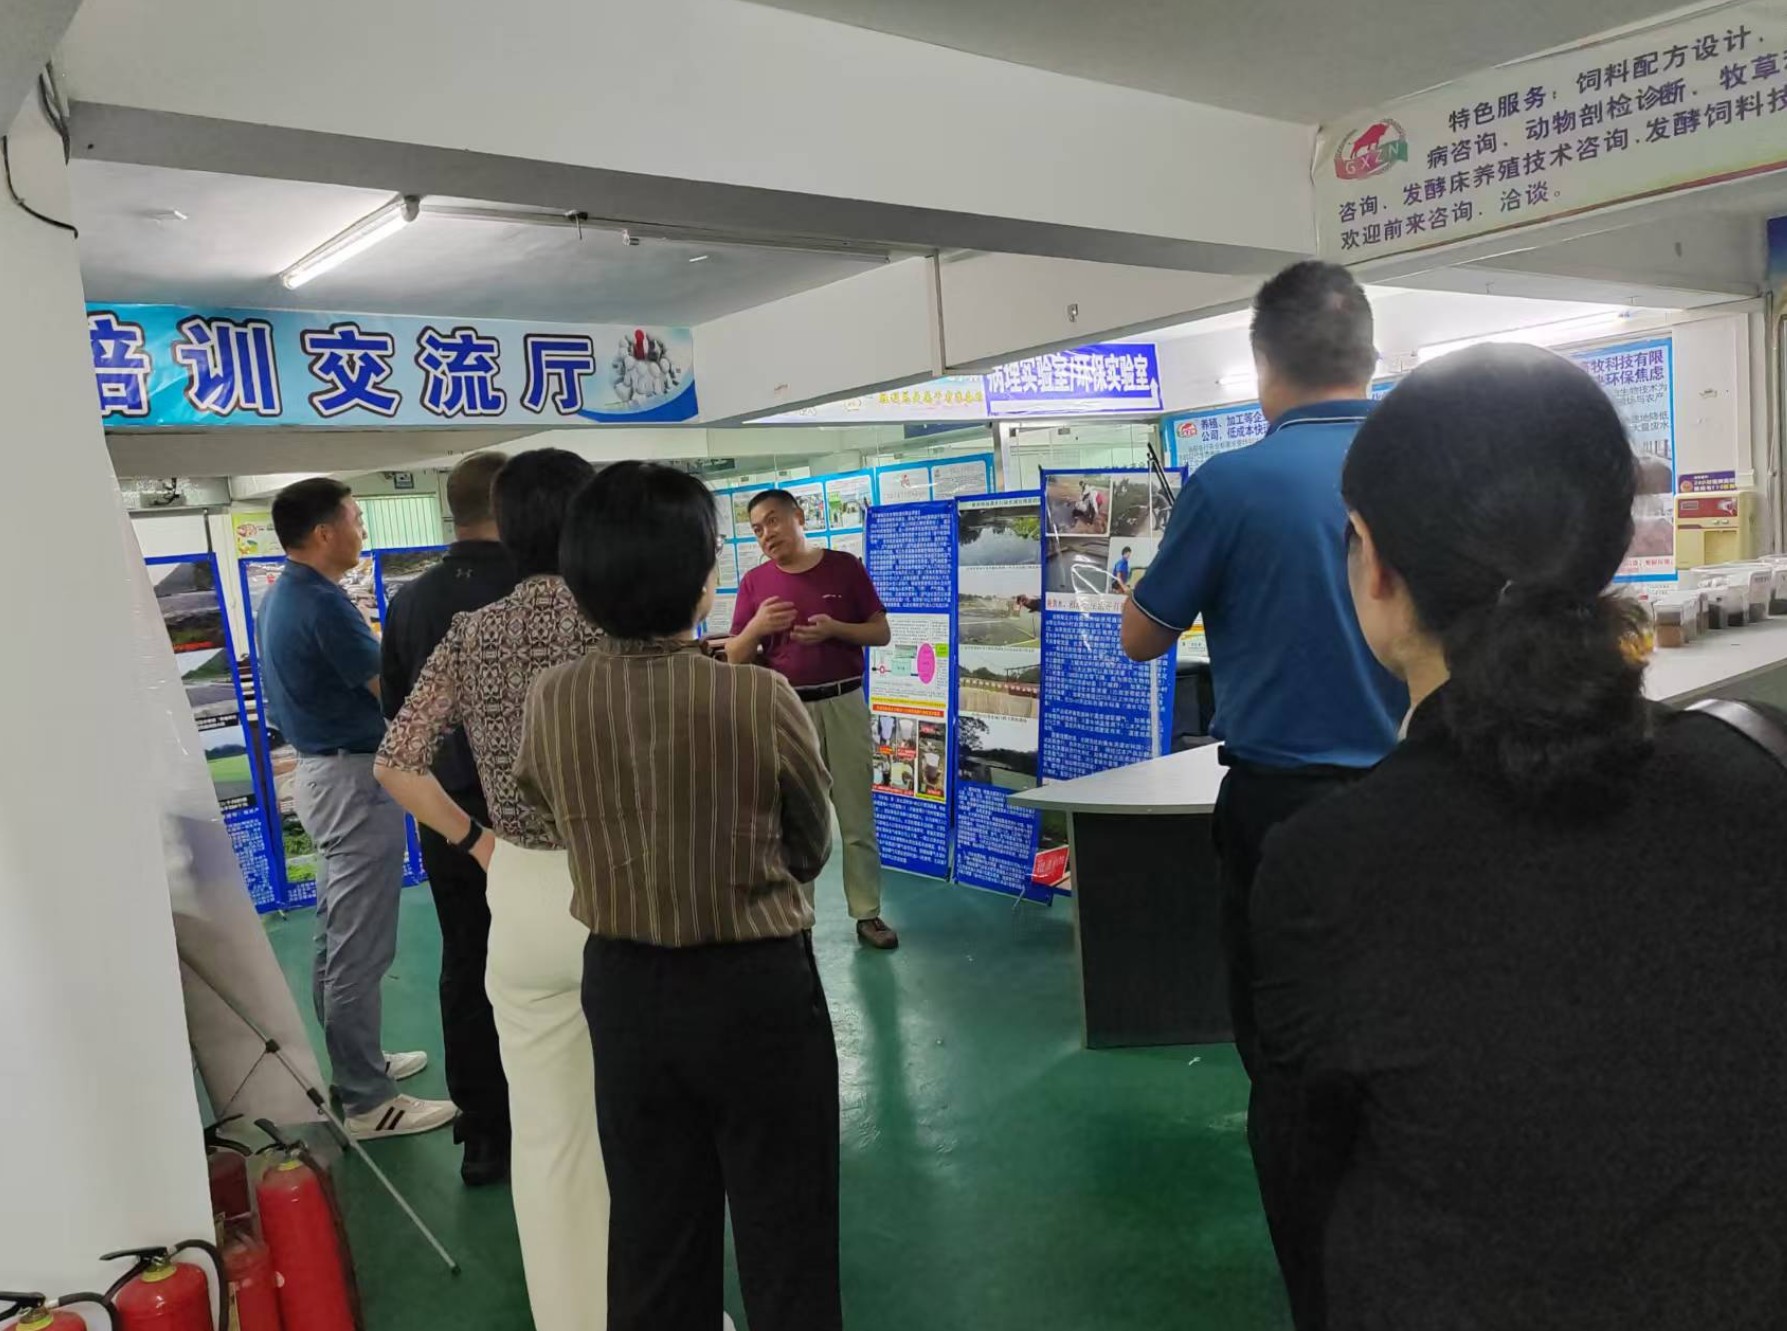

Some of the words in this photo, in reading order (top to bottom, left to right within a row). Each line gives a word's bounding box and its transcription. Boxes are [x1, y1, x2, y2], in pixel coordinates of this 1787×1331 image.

[1427, 49, 1787, 170] 病咨询、动物剖检诊断、牧草
[1345, 144, 1399, 174] GXZN
[87, 313, 597, 419] 培训交流厅
[1599, 366, 1665, 386] 环保焦虑
[1201, 411, 1265, 430] 养殖、加工等企
